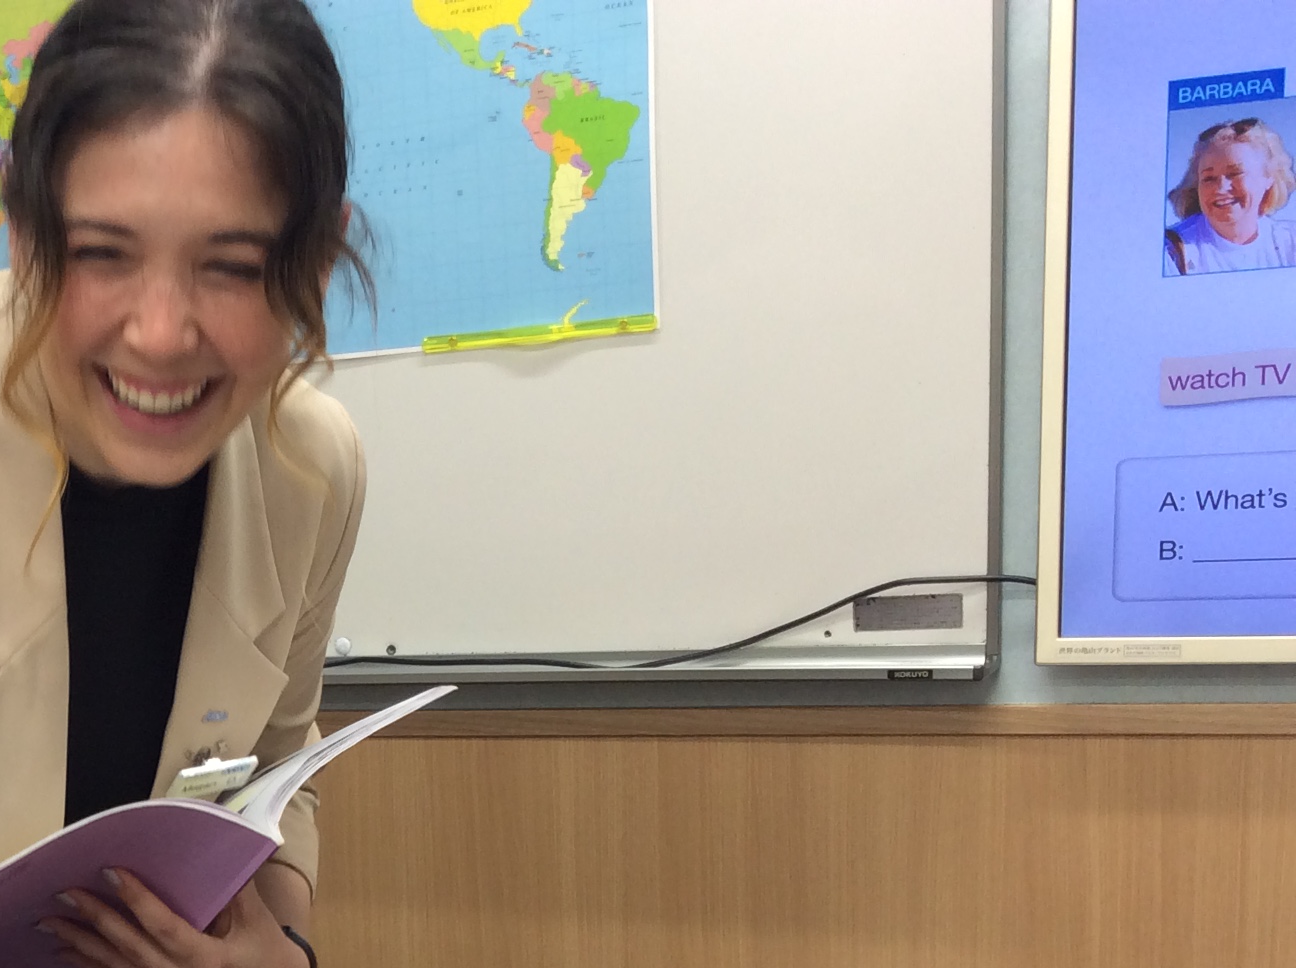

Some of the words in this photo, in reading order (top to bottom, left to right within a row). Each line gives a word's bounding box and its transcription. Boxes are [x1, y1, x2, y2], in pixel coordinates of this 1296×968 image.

[1178, 77, 1275, 104] BARBARA
[1168, 366, 1247, 391] watch
[1255, 363, 1292, 386] TV
[1159, 491, 1185, 513] A:
[1195, 487, 1288, 511] What's
[1159, 540, 1184, 561] B:
[894, 670, 929, 678] KOKUYO
